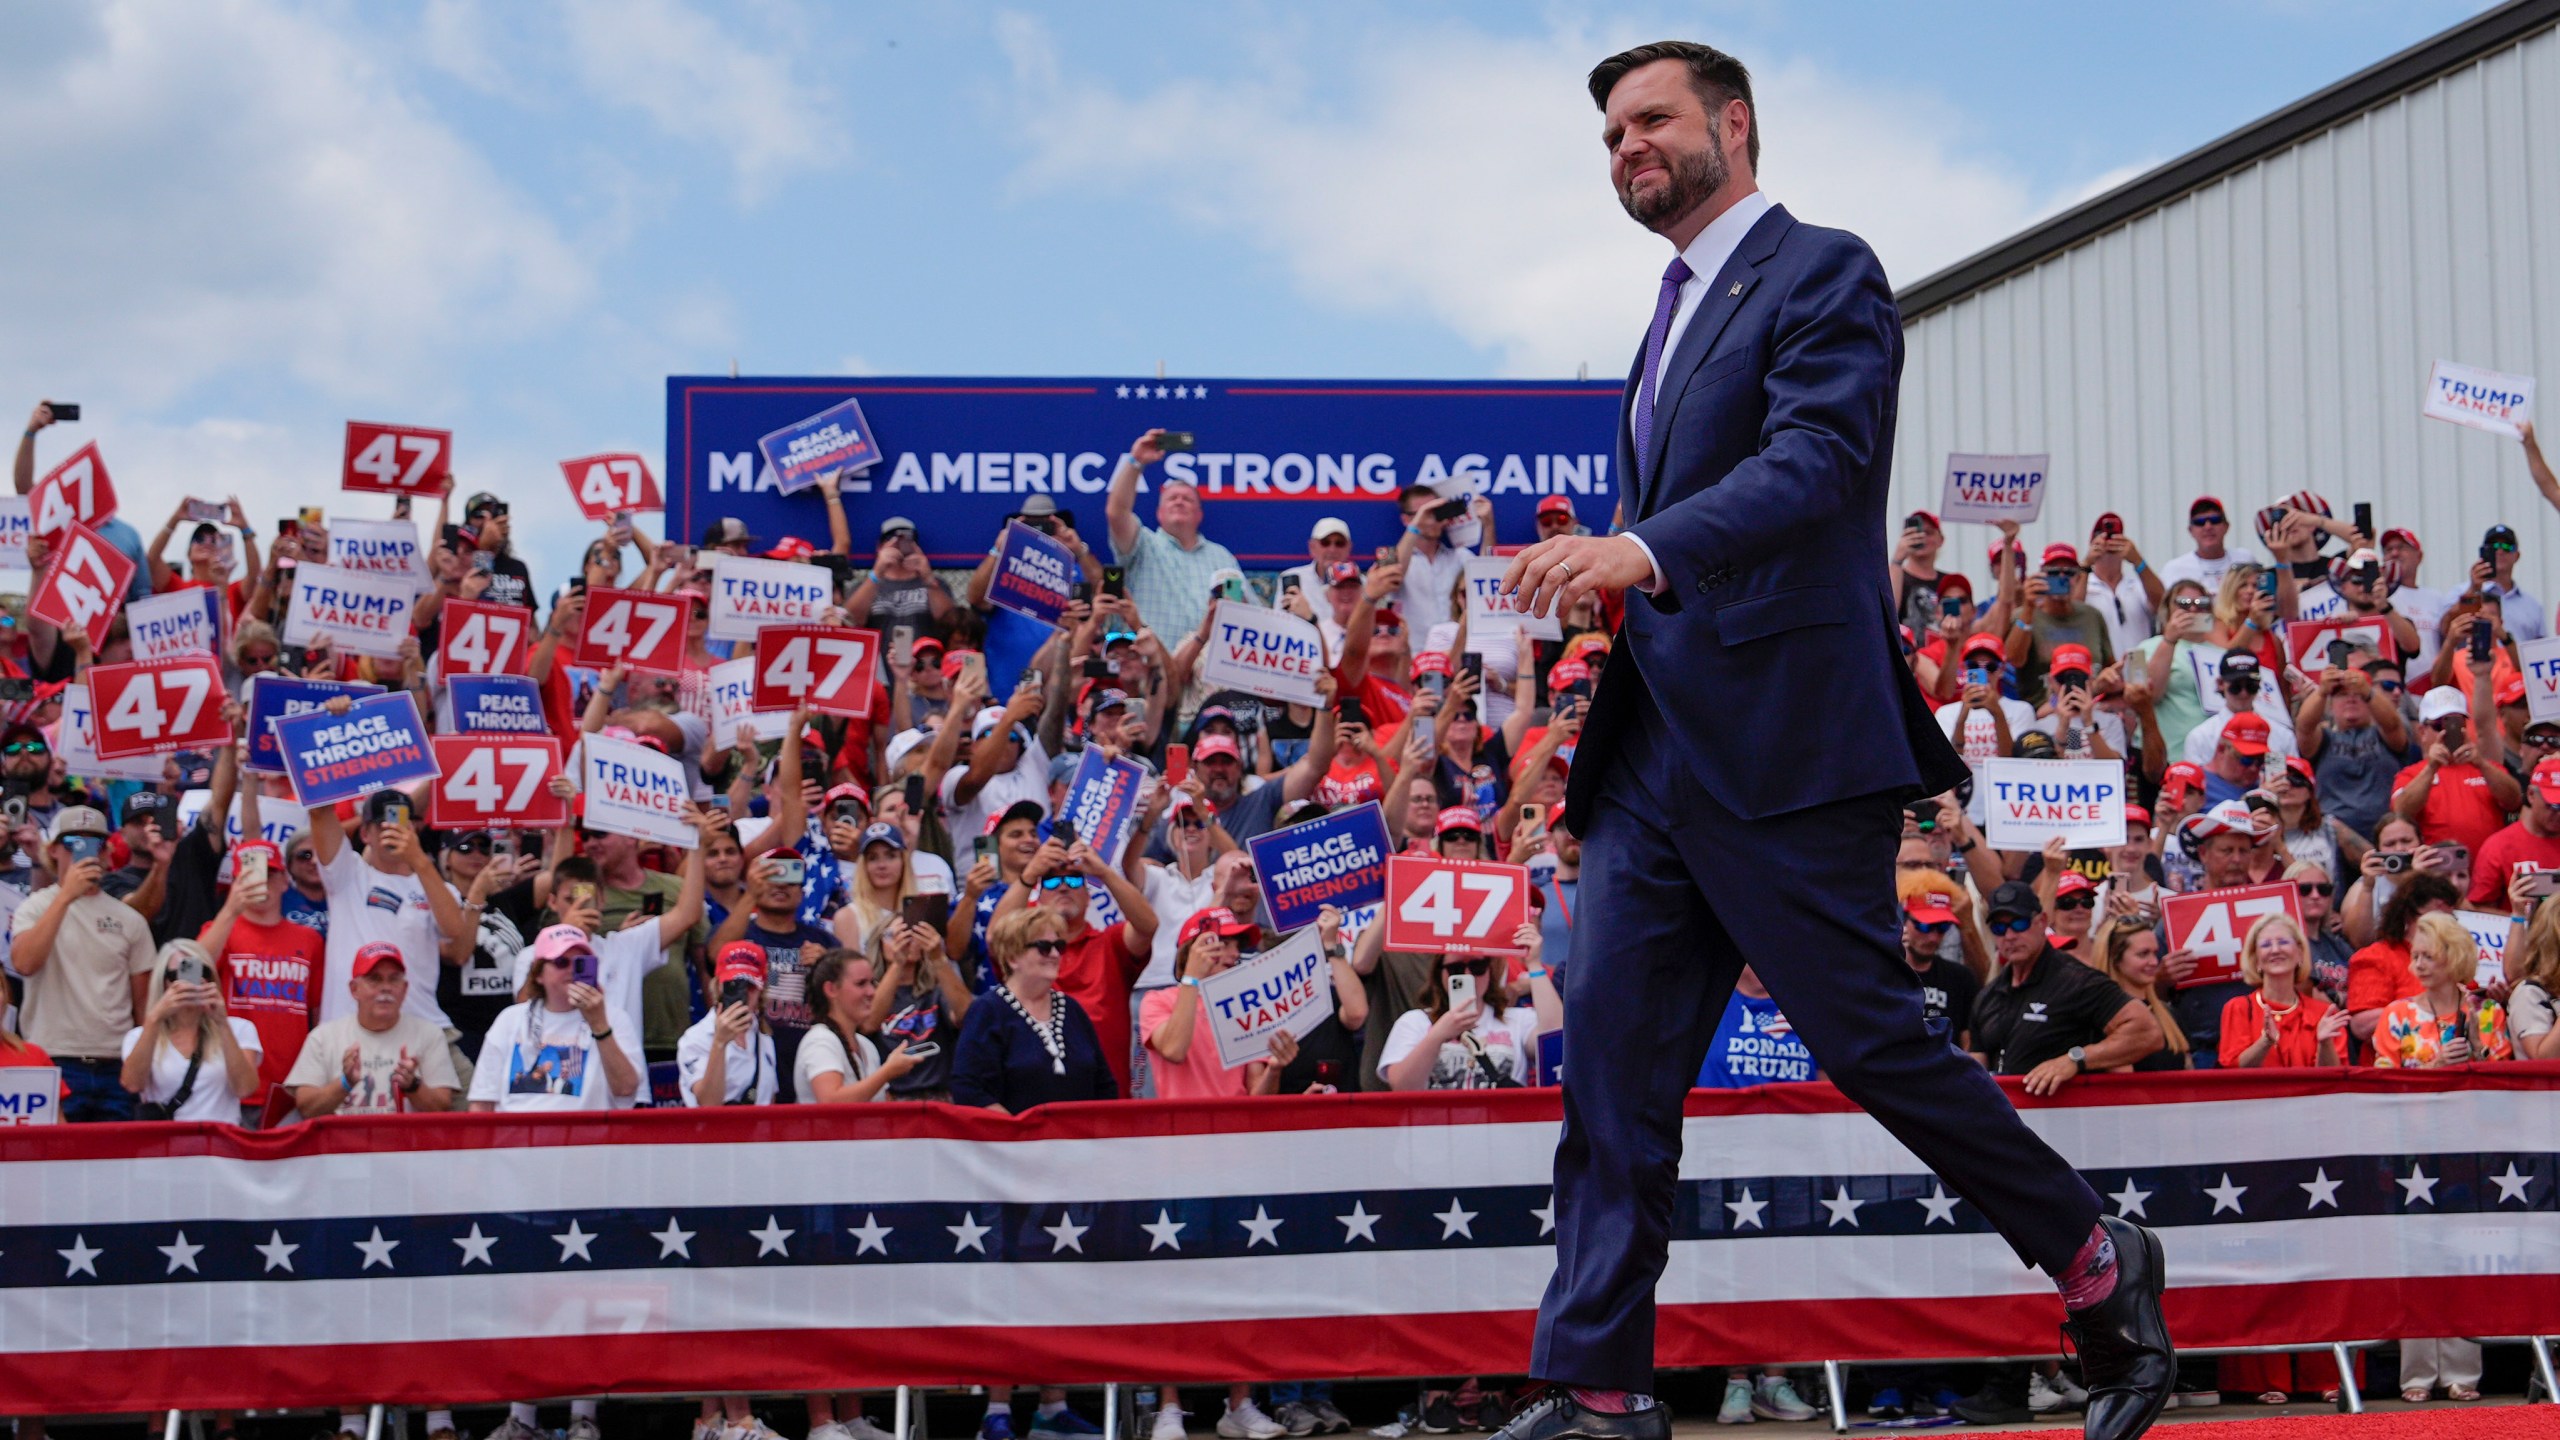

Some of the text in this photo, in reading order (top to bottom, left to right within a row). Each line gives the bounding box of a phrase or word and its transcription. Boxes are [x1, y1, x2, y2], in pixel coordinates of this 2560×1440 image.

[2438, 376, 2524, 409] TRUMP
[2445, 392, 2512, 419] VANCE
[780, 429, 860, 468] THROUGH
[787, 422, 843, 453] PEACE
[352, 433, 441, 487] 47
[708, 451, 1609, 496] ME AMERICA STRONG AGAIN!
[783, 441, 868, 480] STRENGTH
[37, 456, 95, 537] 47
[580, 458, 644, 509] 47
[1953, 471, 2042, 490] TRUMP
[1961, 488, 2032, 504] VANCE
[335, 538, 416, 558] TRUMP
[342, 556, 411, 573] VANCE
[1022, 545, 1064, 578] PEACE
[55, 538, 116, 627] 47
[722, 578, 824, 602] TRUMP
[1000, 572, 1069, 609] STRENGT
[1008, 556, 1070, 598] THROUGH
[303, 584, 405, 616] TRUMP
[733, 598, 812, 618] VANCE
[136, 609, 203, 642] TRUMP
[310, 606, 391, 631] VANCE
[588, 600, 677, 660] 47
[147, 630, 199, 656] VANCE
[448, 613, 521, 674] 47
[1221, 623, 1319, 659] TRUMP
[764, 636, 865, 700] 47
[1230, 645, 1313, 675] VANCE
[105, 667, 211, 740] 47
[479, 694, 531, 712] PEACE
[715, 681, 753, 705] TRU
[312, 715, 390, 748] PEACE
[465, 711, 542, 732] THROUGH
[300, 728, 413, 769] THROUGH
[303, 744, 422, 787] STRENGTH
[443, 747, 550, 813] 47
[594, 758, 684, 796] TRUMP
[605, 782, 681, 813] VANCE
[1072, 777, 1102, 833] EACE
[1994, 782, 2113, 803] TRUMP
[1091, 769, 1131, 850] RENGTH
[2009, 803, 2102, 820] VANCE
[186, 811, 297, 843] TUMP
[1282, 833, 1356, 869] PEACE
[1271, 845, 1379, 892] THROUGH
[1275, 862, 1386, 911] STRENGTH
[1400, 869, 1514, 939] 47
[2182, 895, 2285, 968] 47
[229, 958, 311, 982] TRUMP
[468, 976, 513, 990] FIGH
[1215, 952, 1318, 1020] TRUMP
[233, 979, 307, 1001] VANCE
[1236, 979, 1316, 1032] VANCE
[1739, 1005, 1756, 1034] I
[1727, 1037, 1810, 1060] DONALD
[1726, 1054, 1810, 1082] TRUMP
